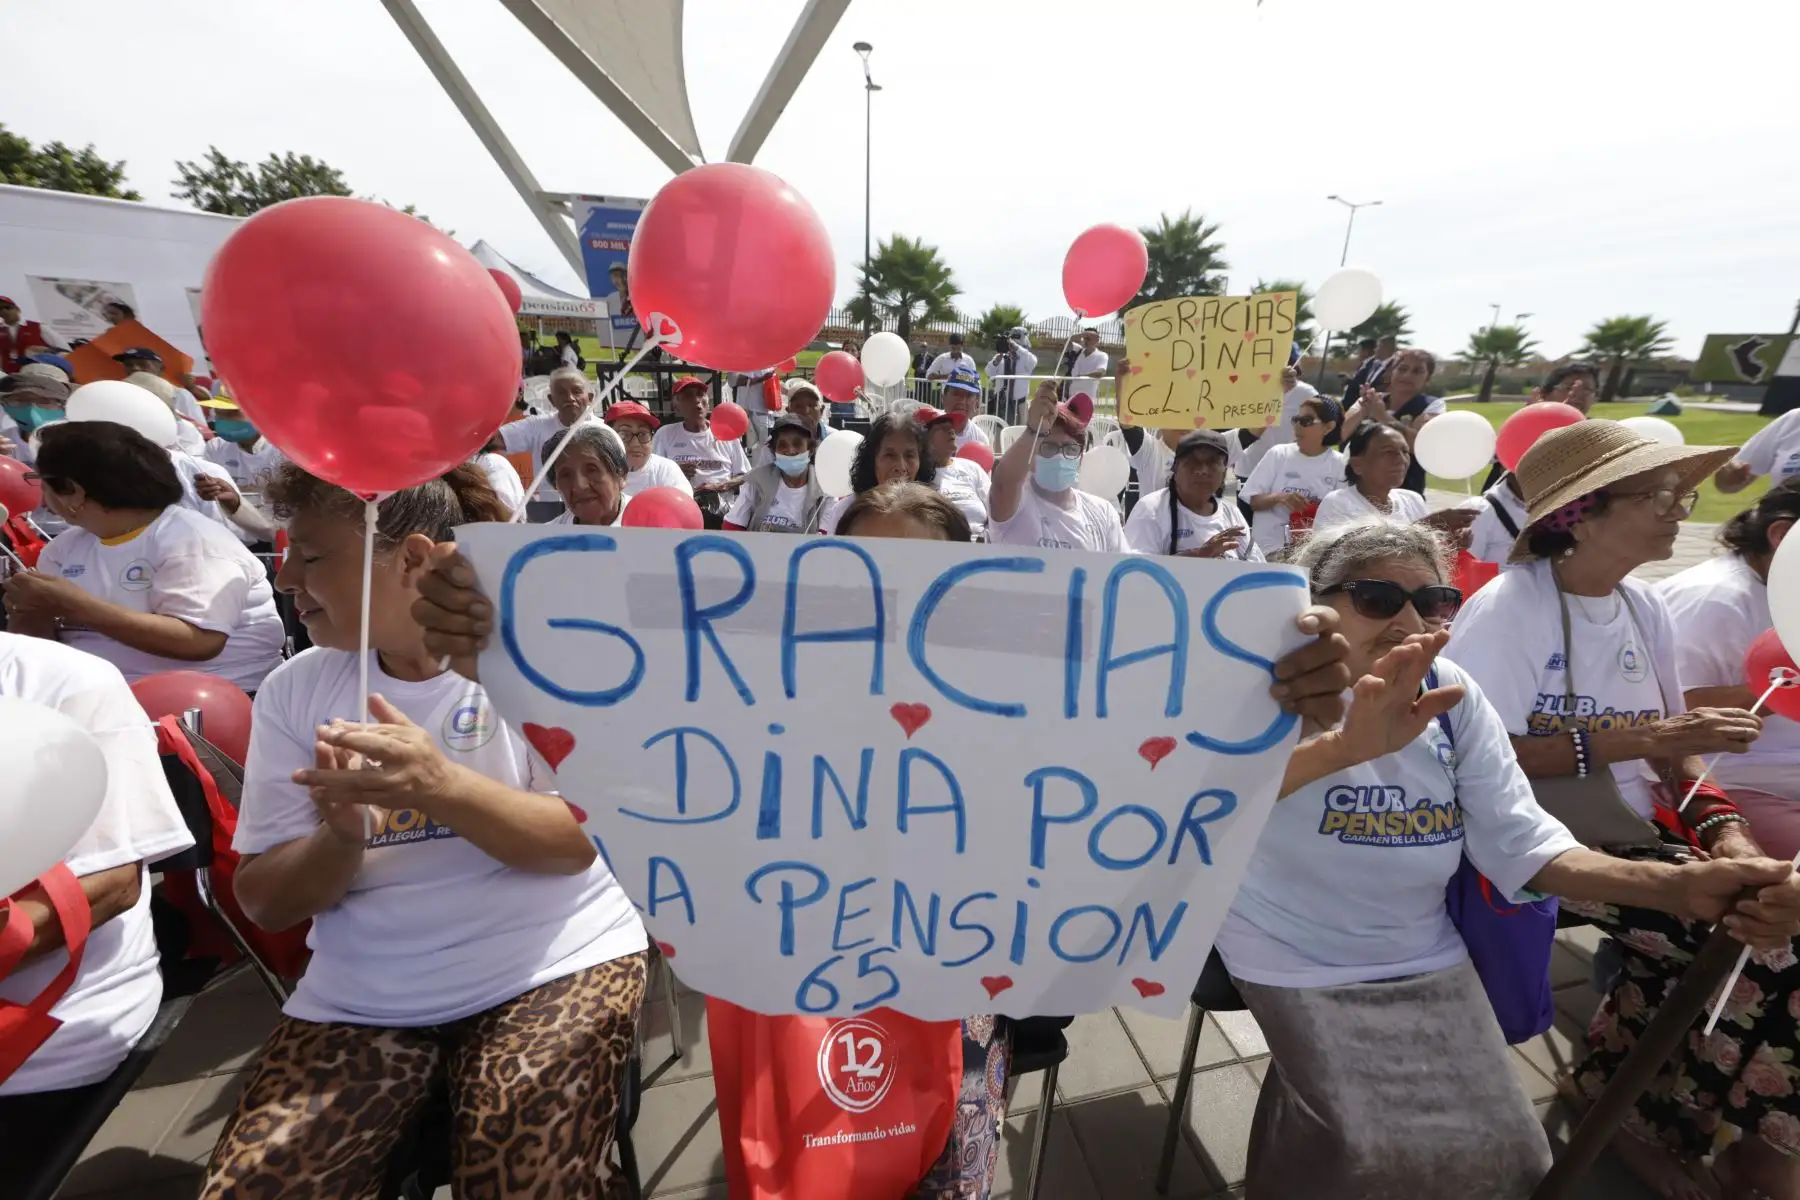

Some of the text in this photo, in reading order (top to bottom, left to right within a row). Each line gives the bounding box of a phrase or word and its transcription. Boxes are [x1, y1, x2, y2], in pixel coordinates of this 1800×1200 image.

[500, 533, 1308, 756] GRACIAS
[1326, 785, 1405, 812] CLUB
[1024, 766, 1239, 870] POR
[1320, 799, 1454, 836] PENSIÓN
[389, 829, 426, 842] LEGUA
[1342, 833, 1389, 844] CARMEN
[1391, 835, 1404, 845] DE
[1405, 835, 1418, 845] LA
[795, 946, 901, 1013] 65
[837, 1031, 885, 1078] 12
[845, 1076, 876, 1094] Años
[803, 1121, 916, 1148] Transformando vidas
